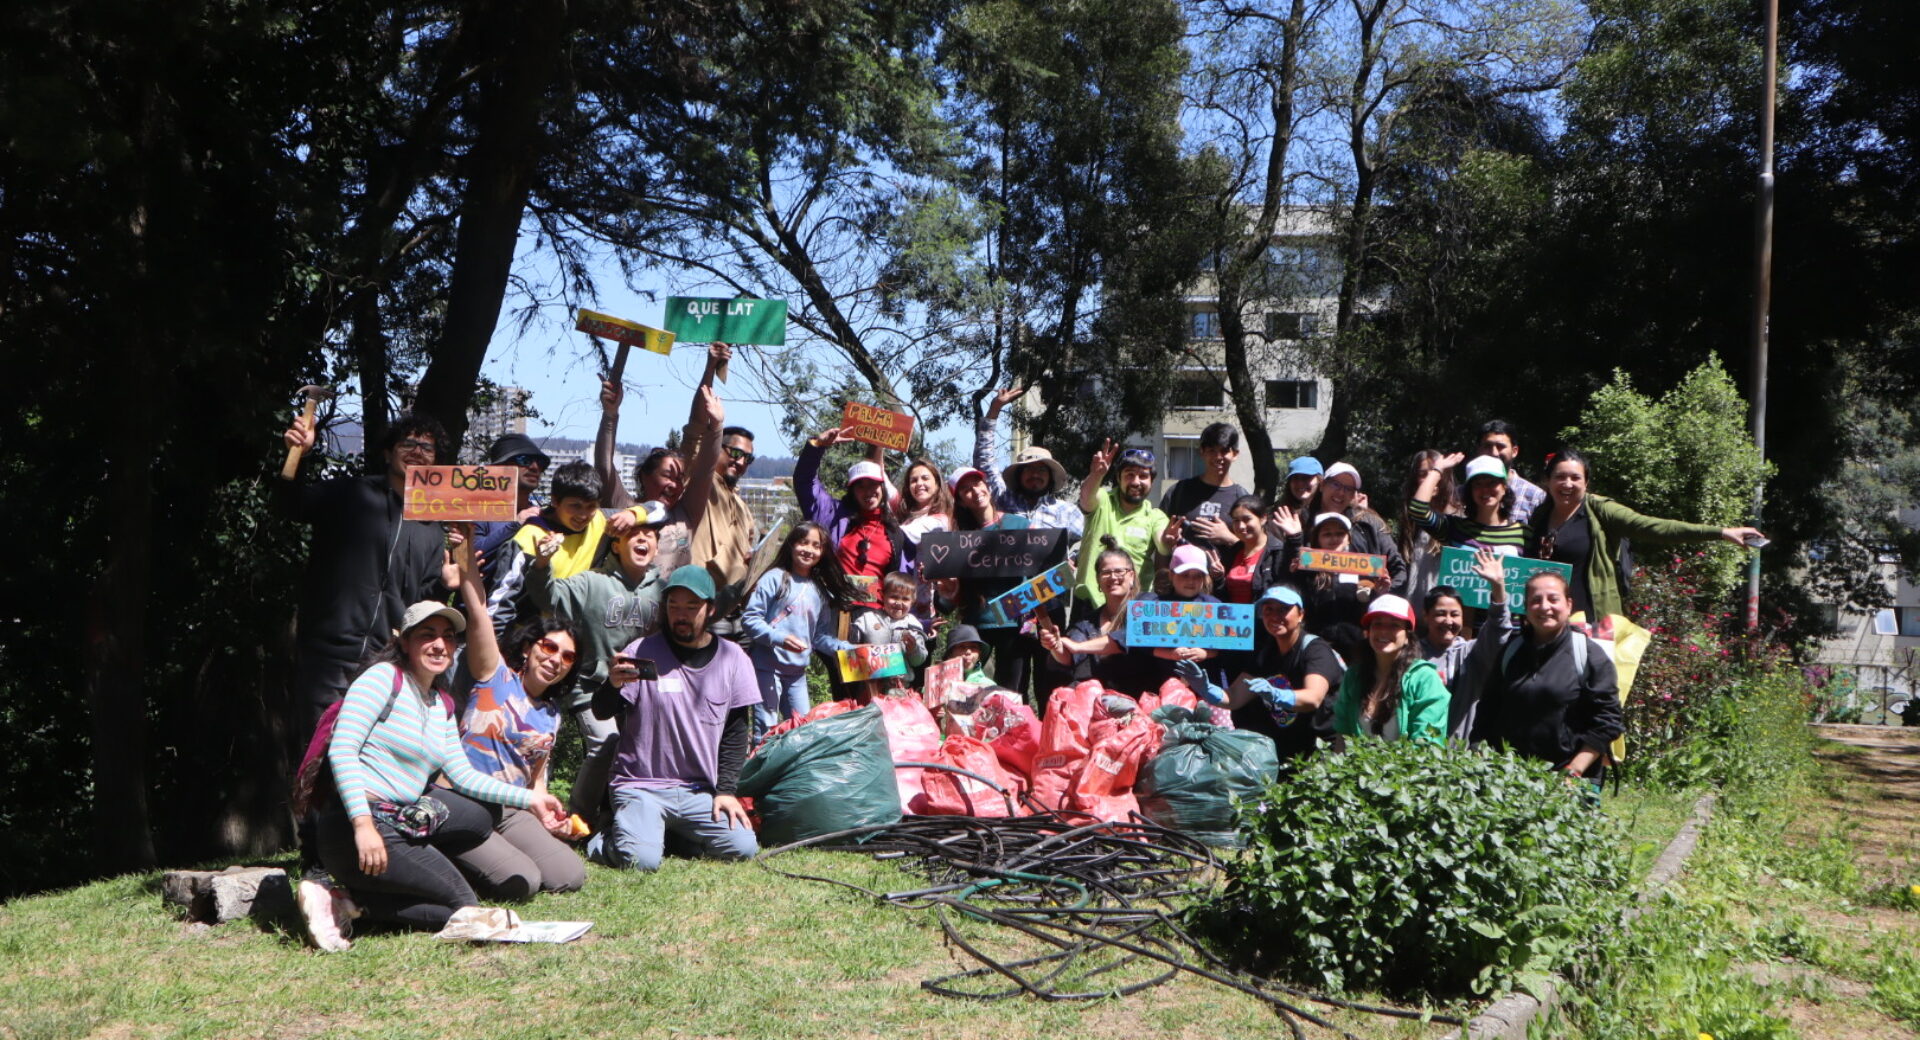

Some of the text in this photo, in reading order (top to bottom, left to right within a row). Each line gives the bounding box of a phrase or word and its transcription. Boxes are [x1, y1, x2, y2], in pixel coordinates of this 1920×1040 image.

[687, 301, 754, 315] QUE LAT
[848, 404, 893, 429] PALMA
[855, 425, 907, 449] CHILENA
[412, 489, 509, 515] Basura
[967, 550, 1033, 568] Cerros
[1322, 553, 1369, 569] PEUMO
[1000, 569, 1066, 620] PEUMO
[1217, 605, 1237, 620] EL
[1132, 621, 1252, 638] CERRO AMARILLO
